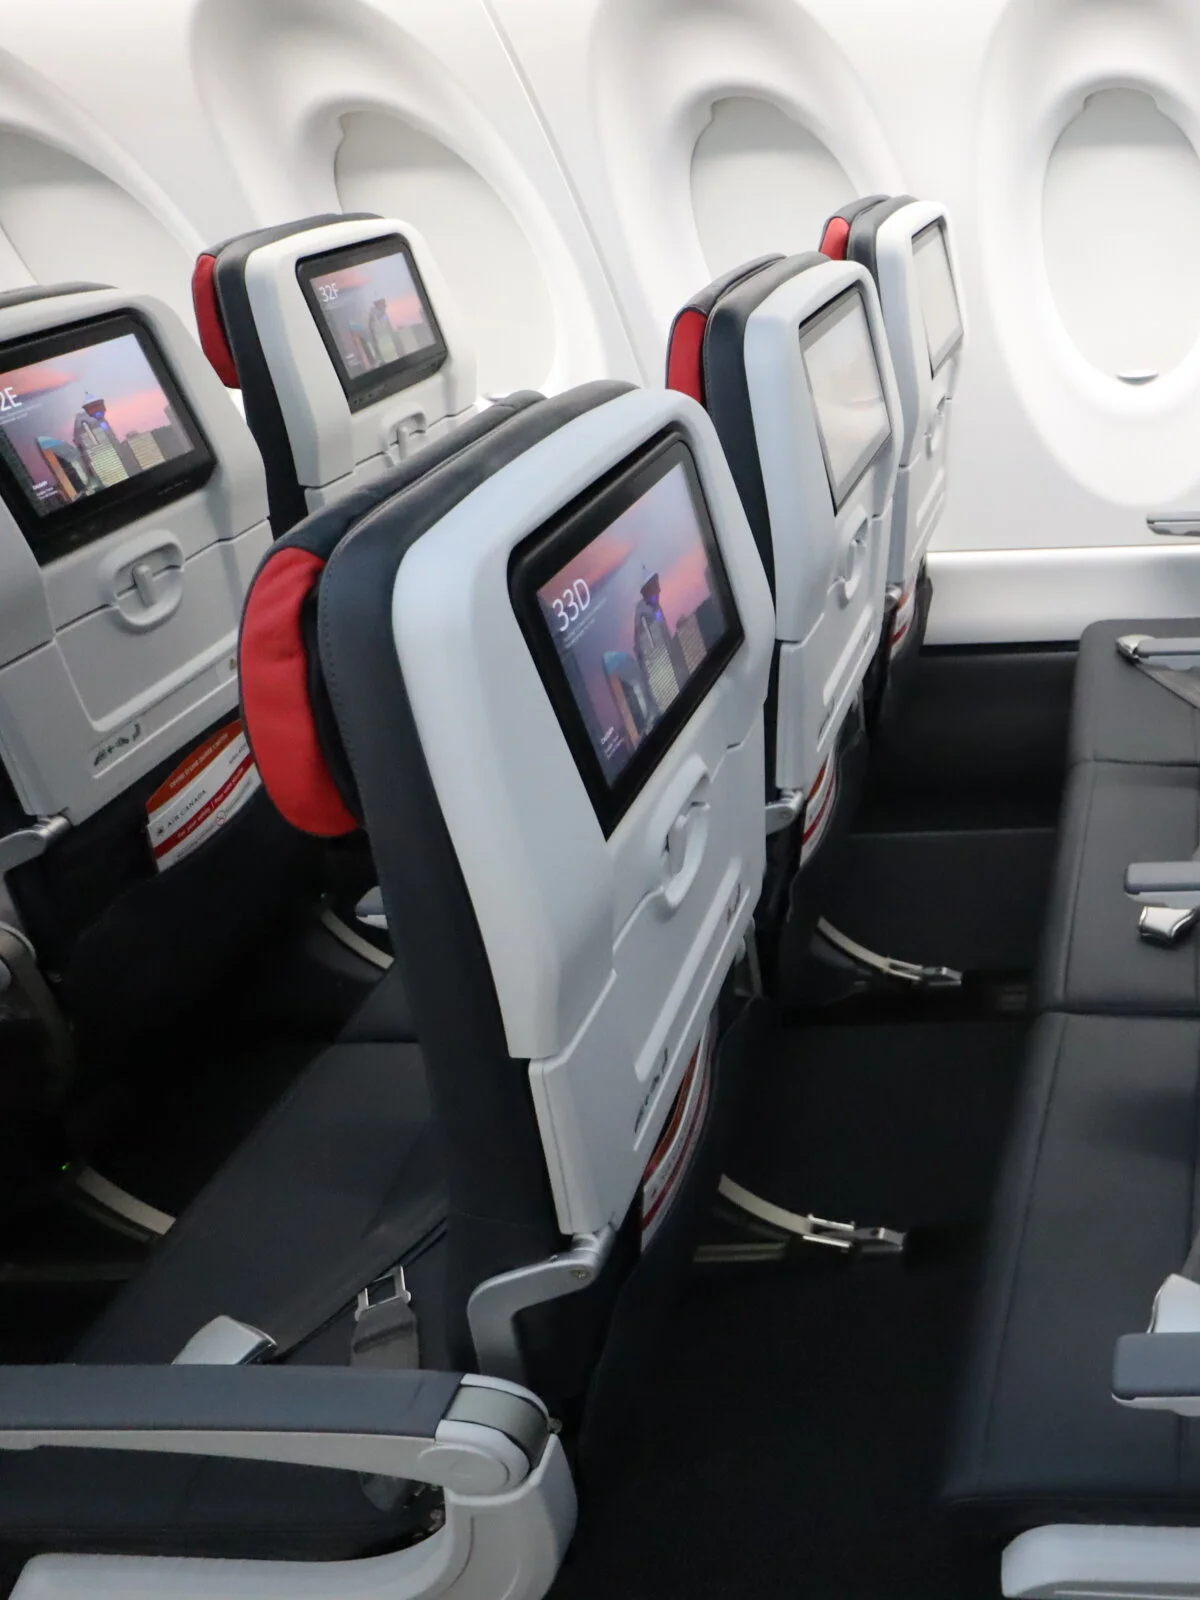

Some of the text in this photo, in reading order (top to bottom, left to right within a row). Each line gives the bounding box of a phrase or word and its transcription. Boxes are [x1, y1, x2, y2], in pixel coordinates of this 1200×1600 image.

[318, 282, 339, 302] 32F
[552, 578, 591, 632] 33D
[167, 815, 180, 828] AIR
[180, 789, 206, 816] CANADA
